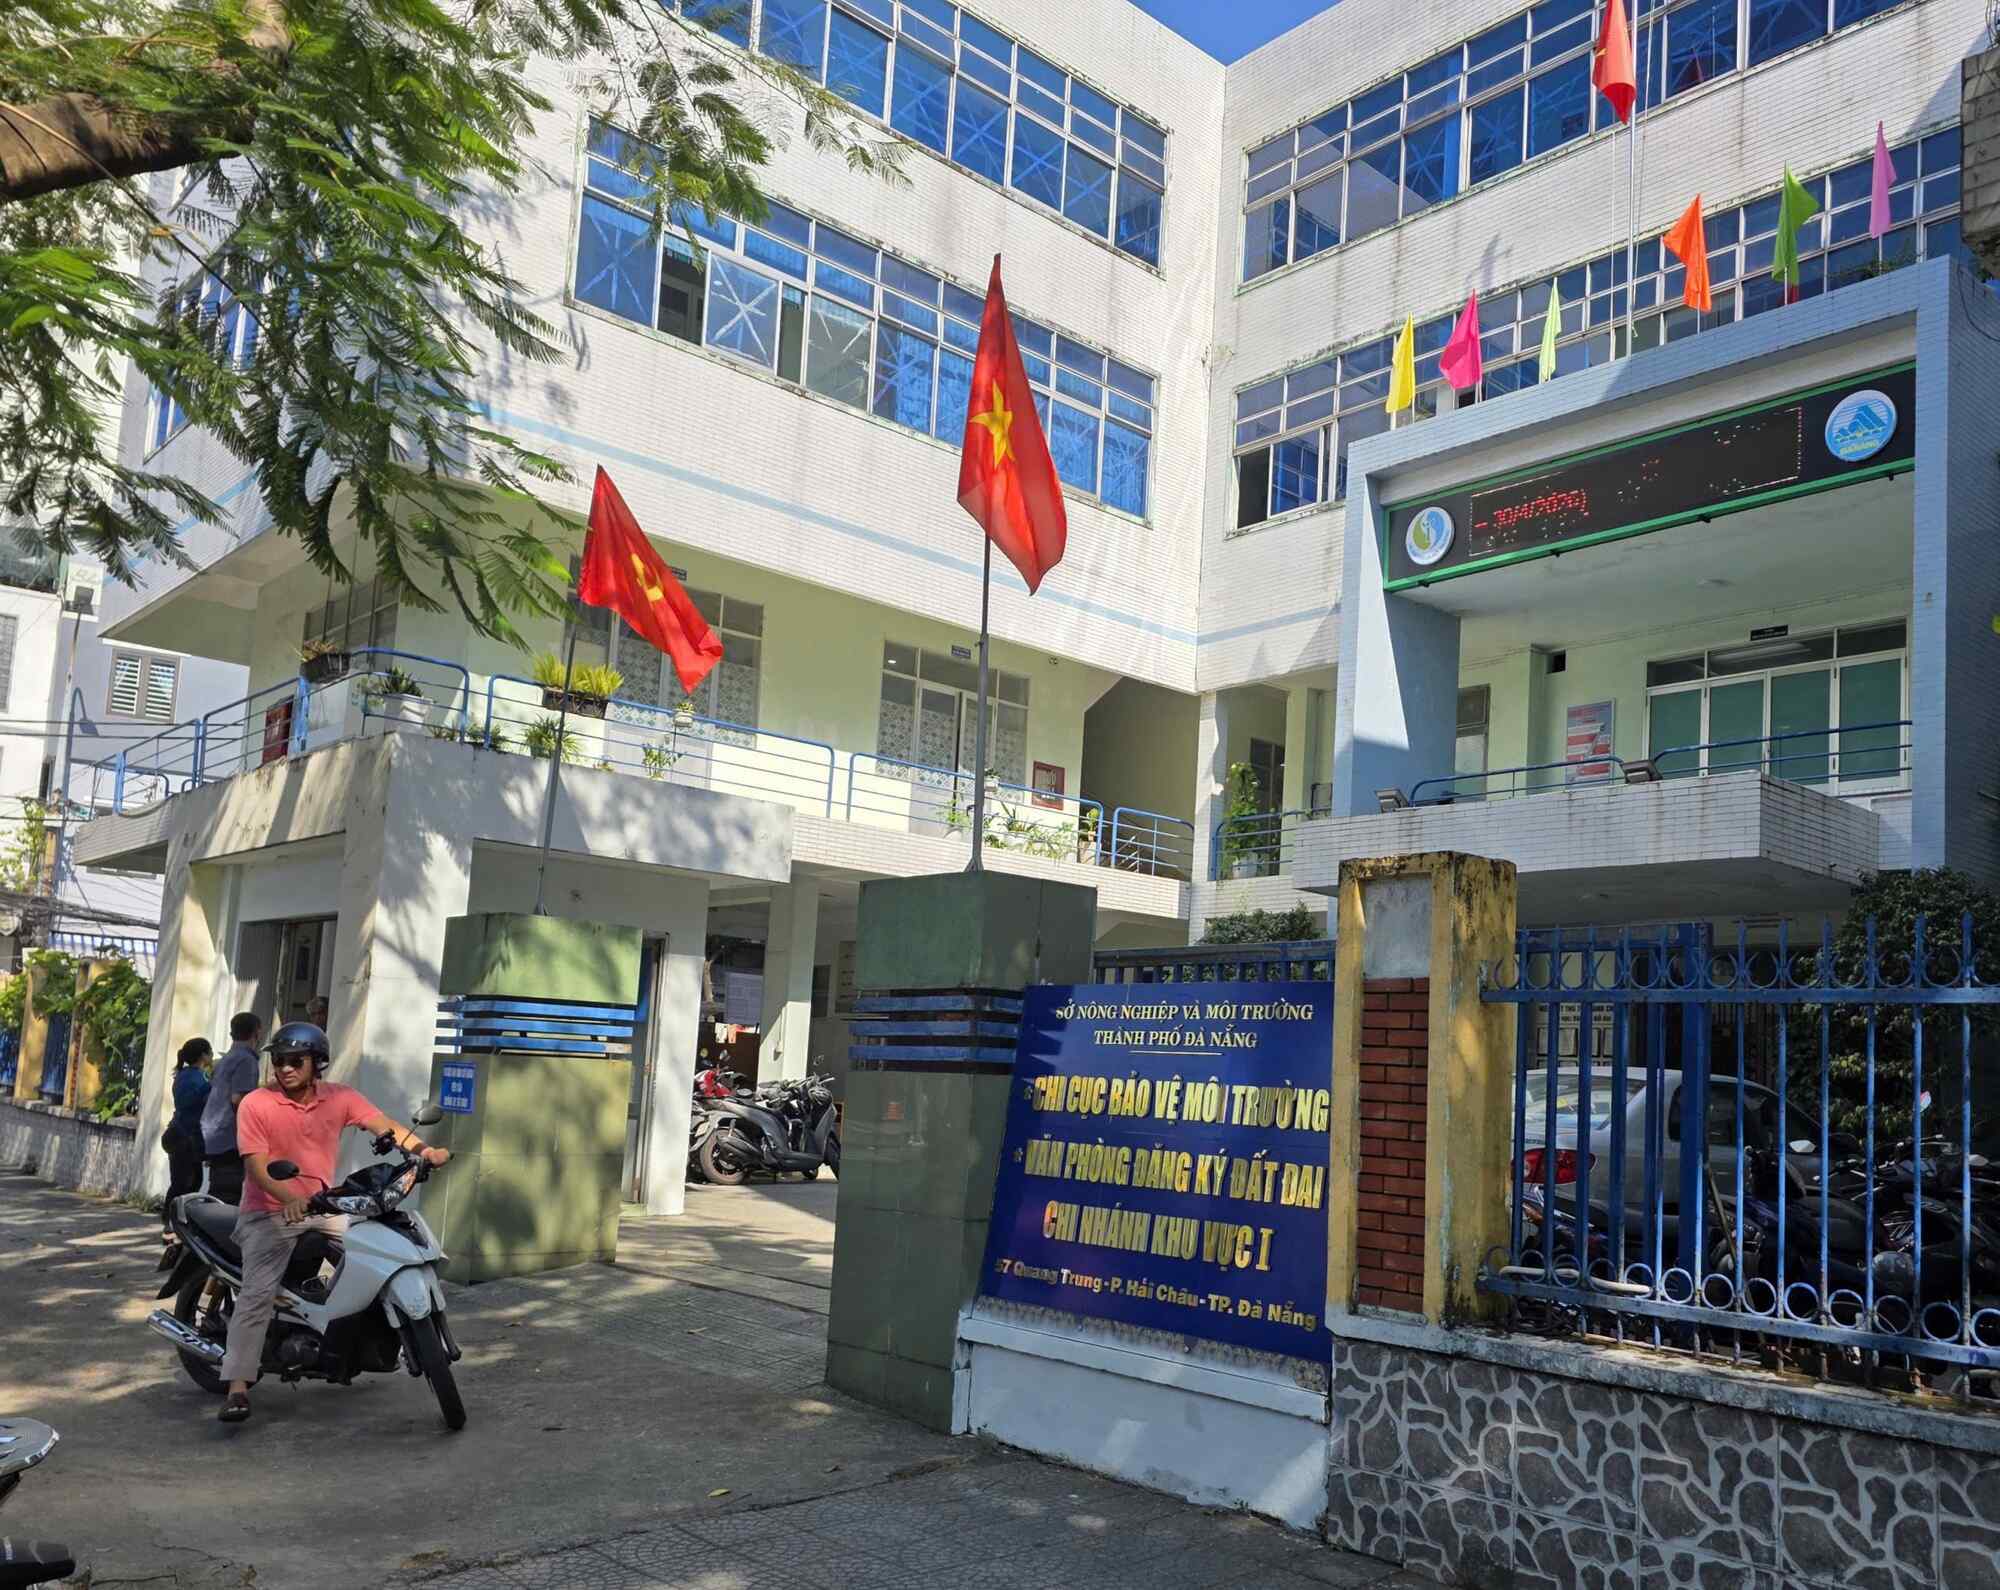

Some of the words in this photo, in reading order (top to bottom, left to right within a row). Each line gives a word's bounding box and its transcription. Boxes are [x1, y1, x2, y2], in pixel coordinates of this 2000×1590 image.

[1056, 998, 1075, 1020] SỞ
[1077, 1001, 1117, 1020] NÔNG
[1119, 1001, 1179, 1023] NGHIỆP
[1183, 1000, 1201, 1020] VÀ
[1204, 1000, 1238, 1020] MÔI
[1241, 997, 1314, 1021] TRƯỜNG
[1094, 1025, 1145, 1046] THÀNH
[1149, 1024, 1184, 1047] PHỐ
[1184, 1025, 1208, 1047] ĐÀ
[1210, 1022, 1258, 1049] NẴNG
[1032, 1075, 1067, 1112] CHI
[1066, 1075, 1108, 1119] CỤC
[1108, 1070, 1152, 1117] BẢO
[1154, 1073, 1183, 1125] VỆ
[1182, 1075, 1228, 1124] MÔI
[1232, 1079, 1331, 1132] TRƯỜNG
[1025, 1134, 1065, 1177] VĂN
[1064, 1137, 1131, 1186] PHÒNG
[1132, 1142, 1193, 1193] ĐĂNG
[1194, 1148, 1228, 1196] KÝ
[1230, 1149, 1279, 1202] ĐẤT
[1280, 1161, 1325, 1209] ĐAI
[1043, 1200, 1079, 1242] CHI
[1078, 1202, 1151, 1252] NHÁNH
[1151, 1214, 1199, 1260] KHU
[1203, 1219, 1254, 1272] VỰC
[1255, 1227, 1276, 1271] I
[1014, 1261, 1058, 1285] Quang
[1126, 1276, 1153, 1299] Hải
[1237, 1299, 1262, 1319] Đà
[1267, 1300, 1317, 1331] Nẵng
